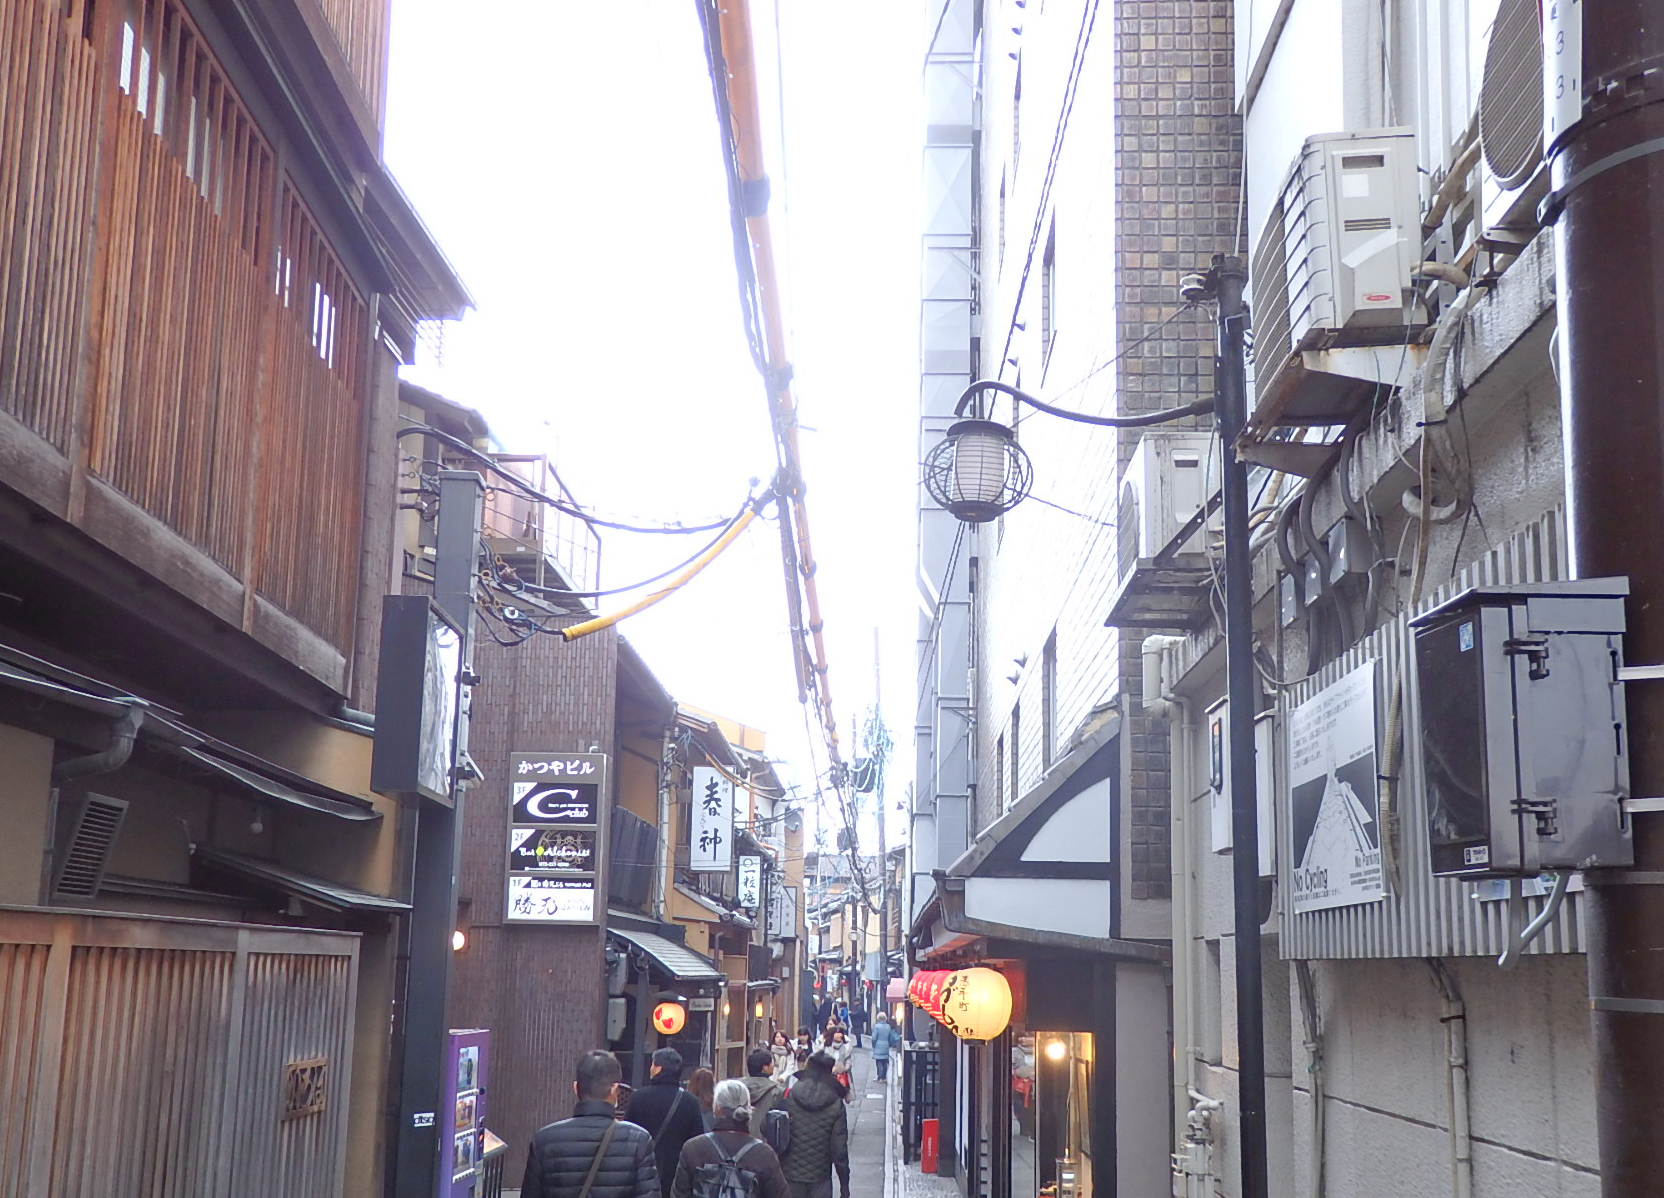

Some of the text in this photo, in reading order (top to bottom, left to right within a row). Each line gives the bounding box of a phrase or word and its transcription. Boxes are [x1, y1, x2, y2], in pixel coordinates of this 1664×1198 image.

[517, 760, 595, 776] かつやビル
[516, 785, 527, 796] 3F
[700, 776, 723, 862] 春神
[514, 832, 525, 842] 2F
[1294, 870, 1304, 894] No
[1304, 866, 1328, 894] Cycling
